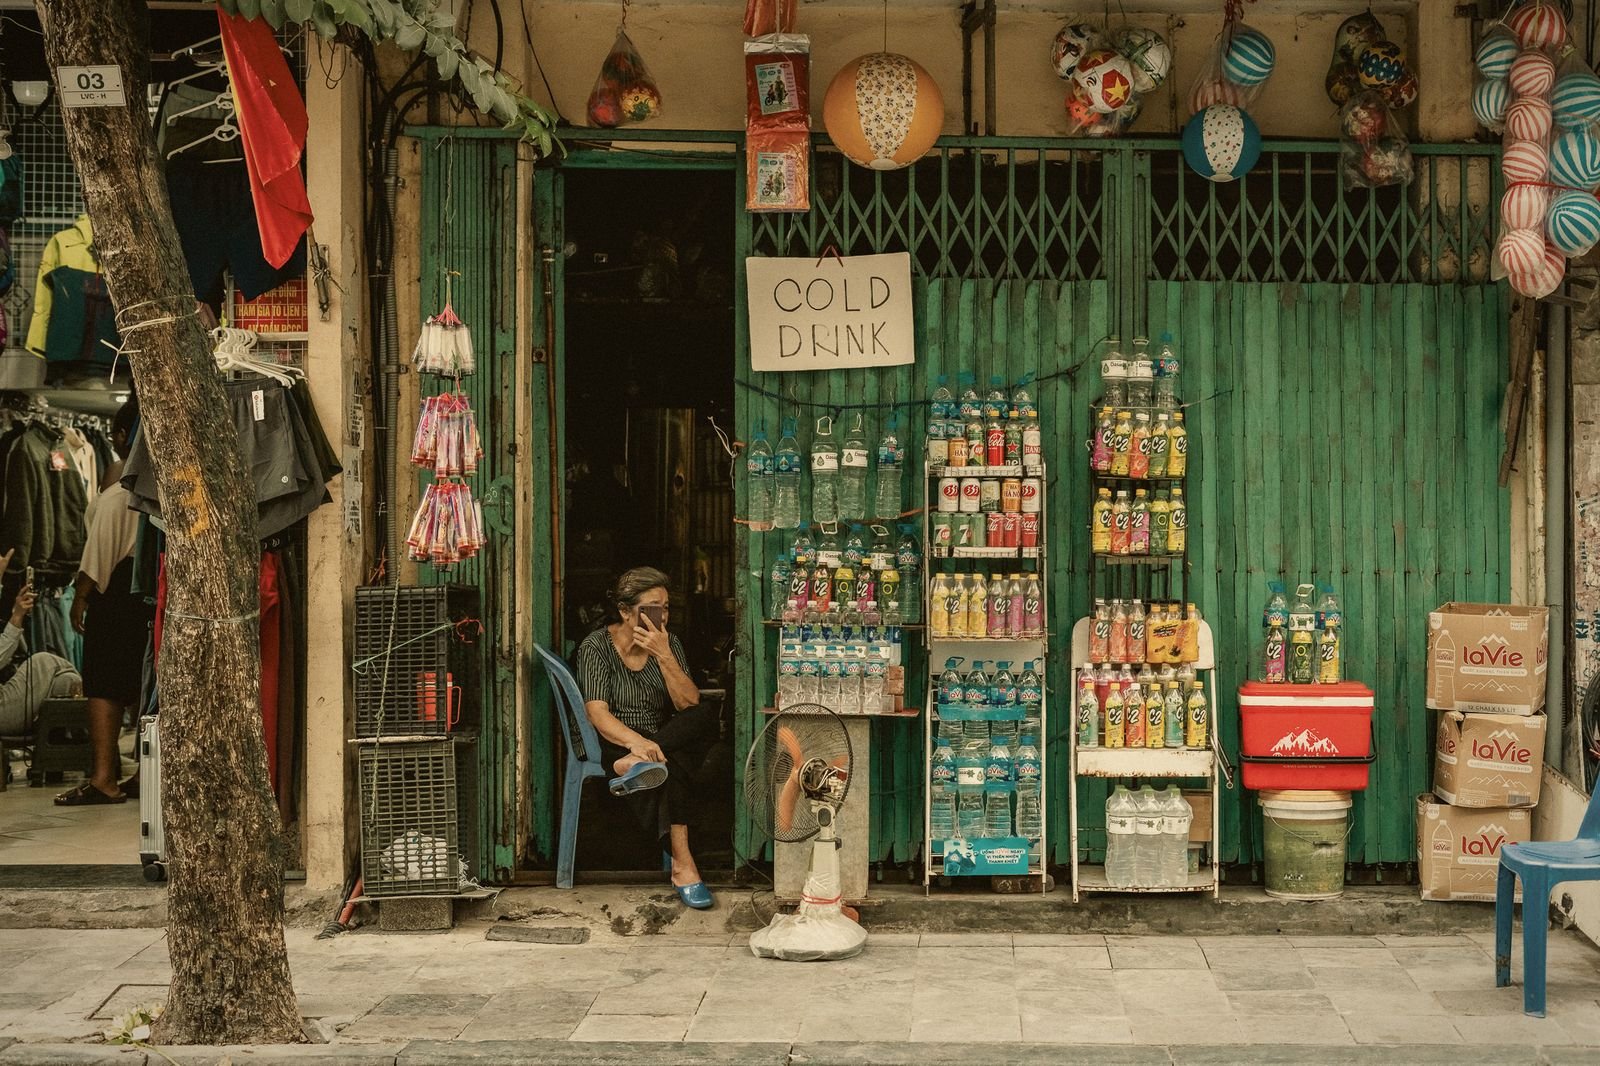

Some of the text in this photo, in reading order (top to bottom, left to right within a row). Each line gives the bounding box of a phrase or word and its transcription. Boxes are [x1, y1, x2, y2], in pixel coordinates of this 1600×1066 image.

[76, 73, 105, 90] 03
[773, 276, 891, 313] COLD
[257, 305, 271, 317] GIA
[779, 321, 890, 358] DRINK
[1115, 435, 1128, 452] C2
[1151, 436, 1166, 453] C2
[1115, 513, 1130, 530] C2
[1131, 511, 1144, 528] C2
[1172, 509, 1185, 527] C2
[791, 577, 806, 595] C2
[813, 577, 829, 597] C2
[856, 581, 869, 597] C2
[1025, 598, 1039, 614] C2
[1095, 622, 1108, 638] C2
[1130, 622, 1144, 639] C2
[1266, 642, 1282, 659] C2
[1321, 644, 1335, 660] C2
[1463, 644, 1524, 667] laVie
[1108, 708, 1122, 724] C2
[1126, 707, 1140, 724] C2
[1149, 708, 1162, 725] C2
[1192, 708, 1206, 724] C2
[1472, 739, 1531, 763] laVie
